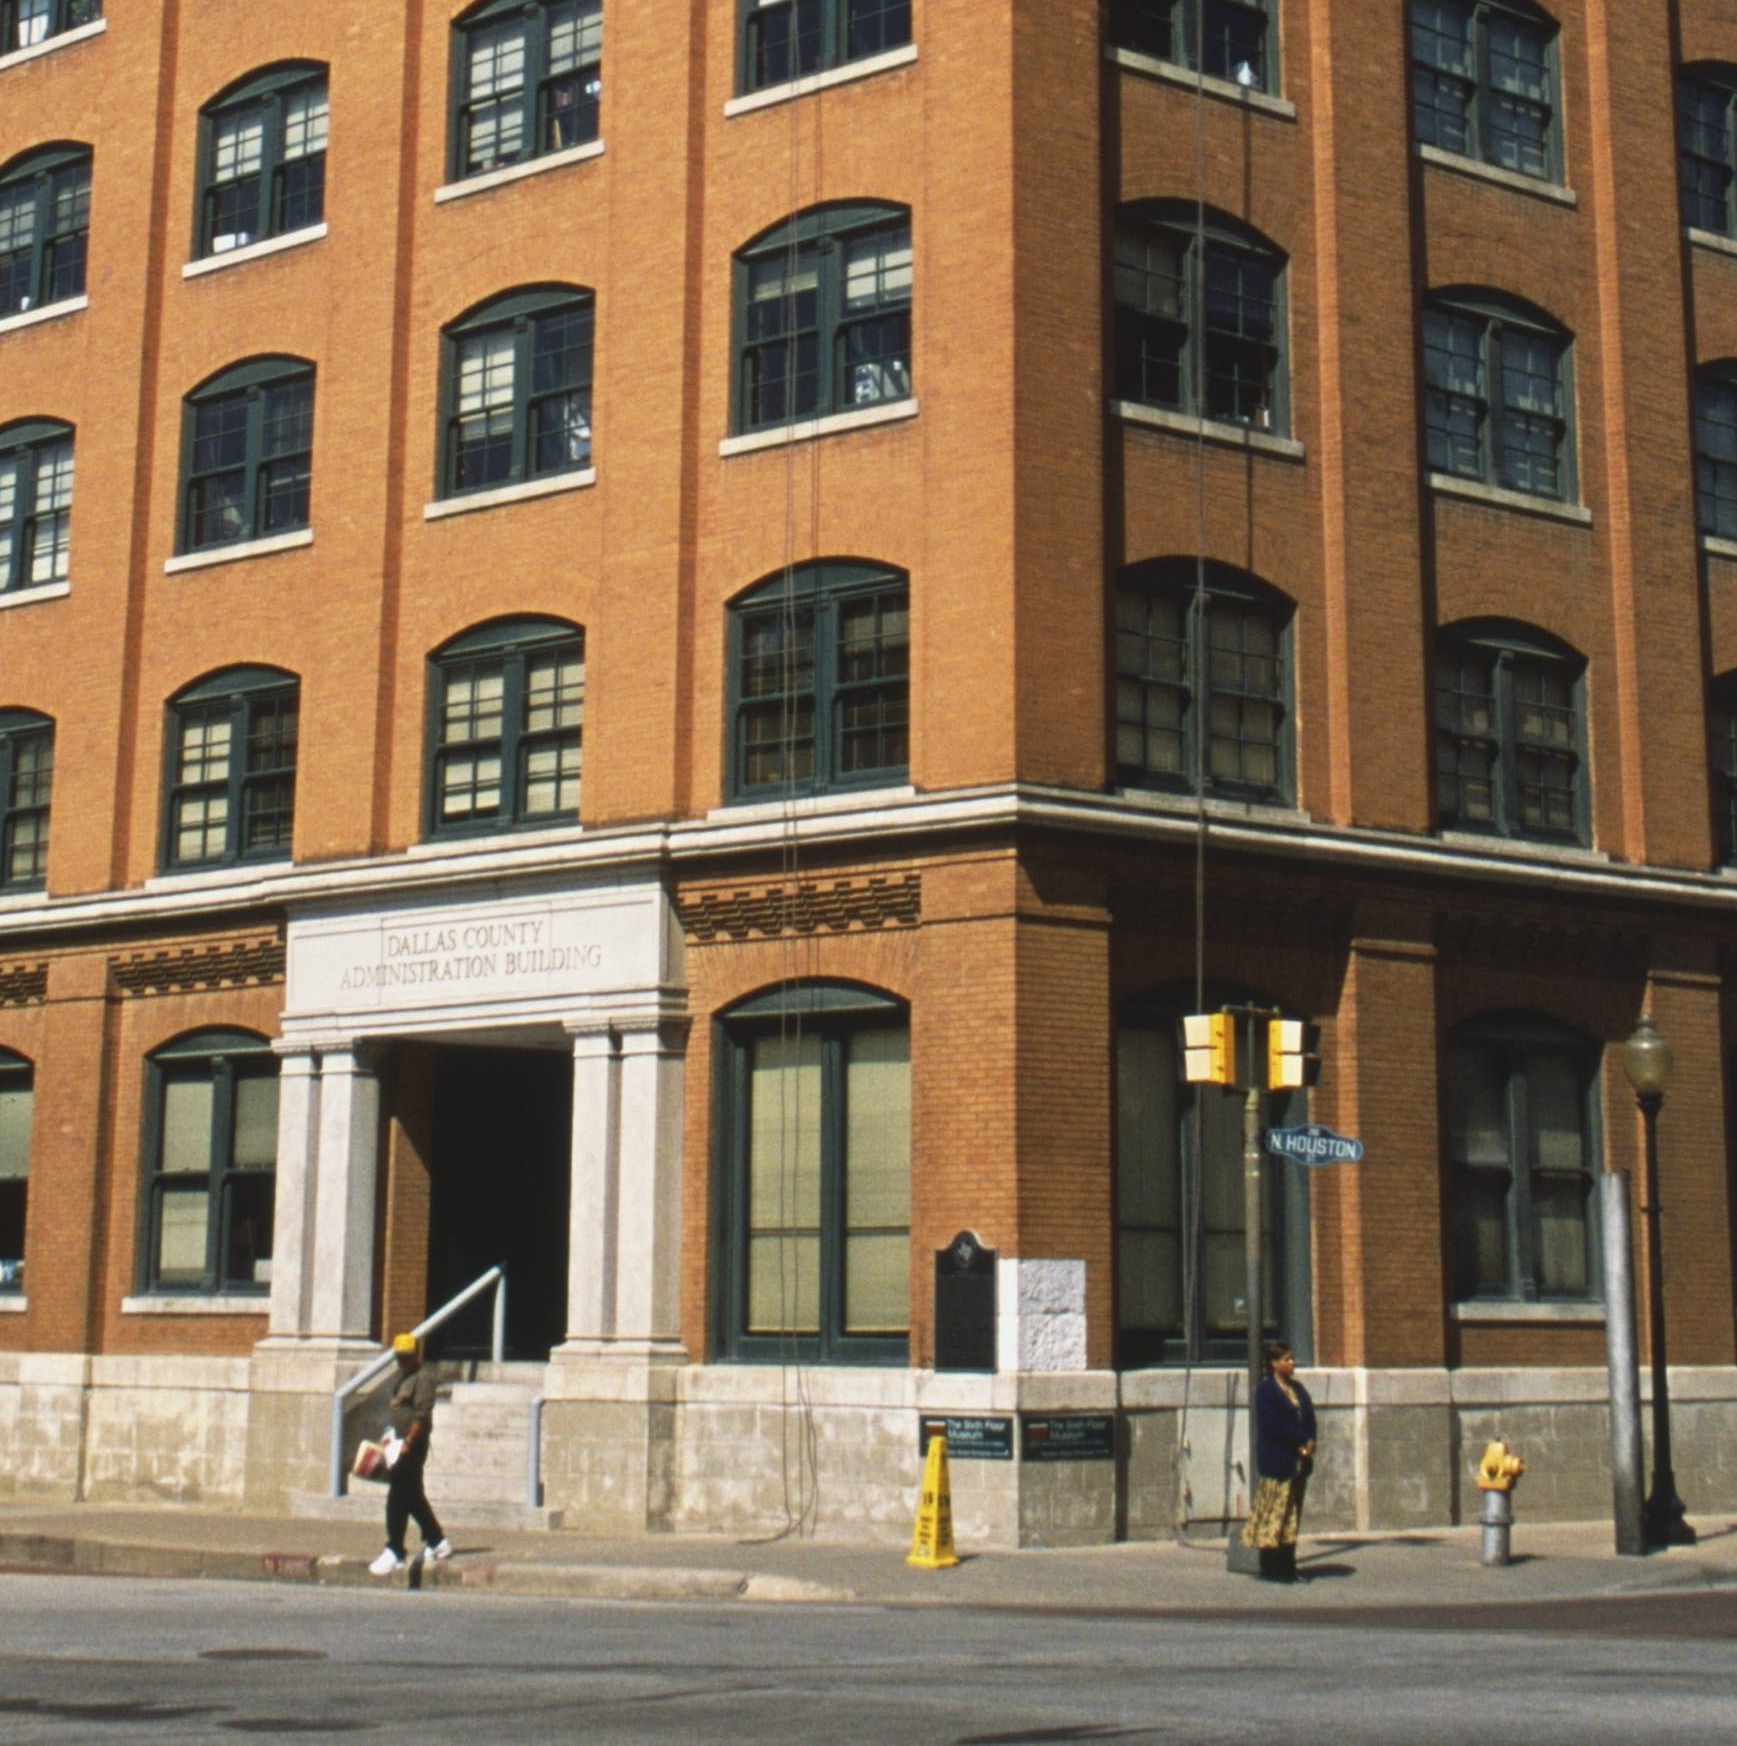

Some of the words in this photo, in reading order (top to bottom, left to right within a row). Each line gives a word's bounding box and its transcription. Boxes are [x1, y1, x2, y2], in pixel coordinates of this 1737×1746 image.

[387, 928, 457, 958] DALLAS
[462, 920, 544, 950] COUNTY
[340, 954, 497, 991] ADMINISTRATION
[504, 943, 602, 976] BUILDING
[1285, 1133, 1357, 1159] HOUSTON
